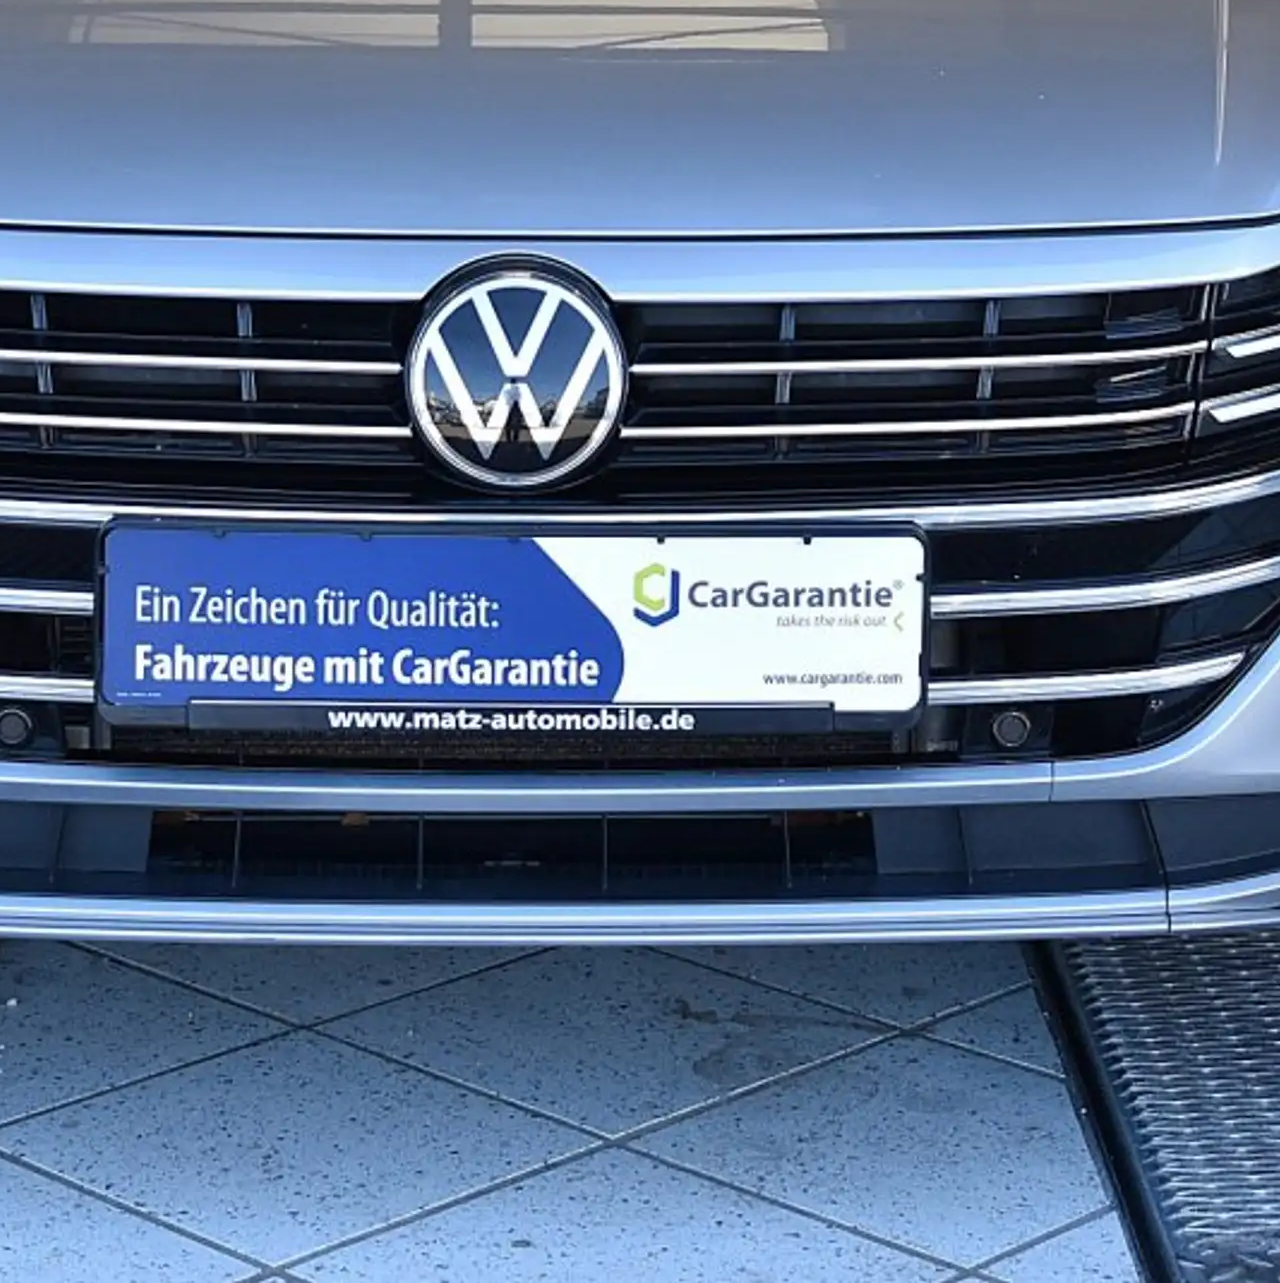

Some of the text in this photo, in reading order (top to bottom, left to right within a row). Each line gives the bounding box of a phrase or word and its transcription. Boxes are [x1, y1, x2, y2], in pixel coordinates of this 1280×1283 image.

[418, 274, 615, 468] VW
[135, 584, 500, 630] Ein Zeichen für Qualität:
[776, 614, 888, 627] takes the risk out
[134, 643, 601, 693] Fahrzeuge mit CarGarantie
[762, 670, 904, 688] www.cargarantie.com
[327, 707, 695, 731] www.matz-automobile.de
